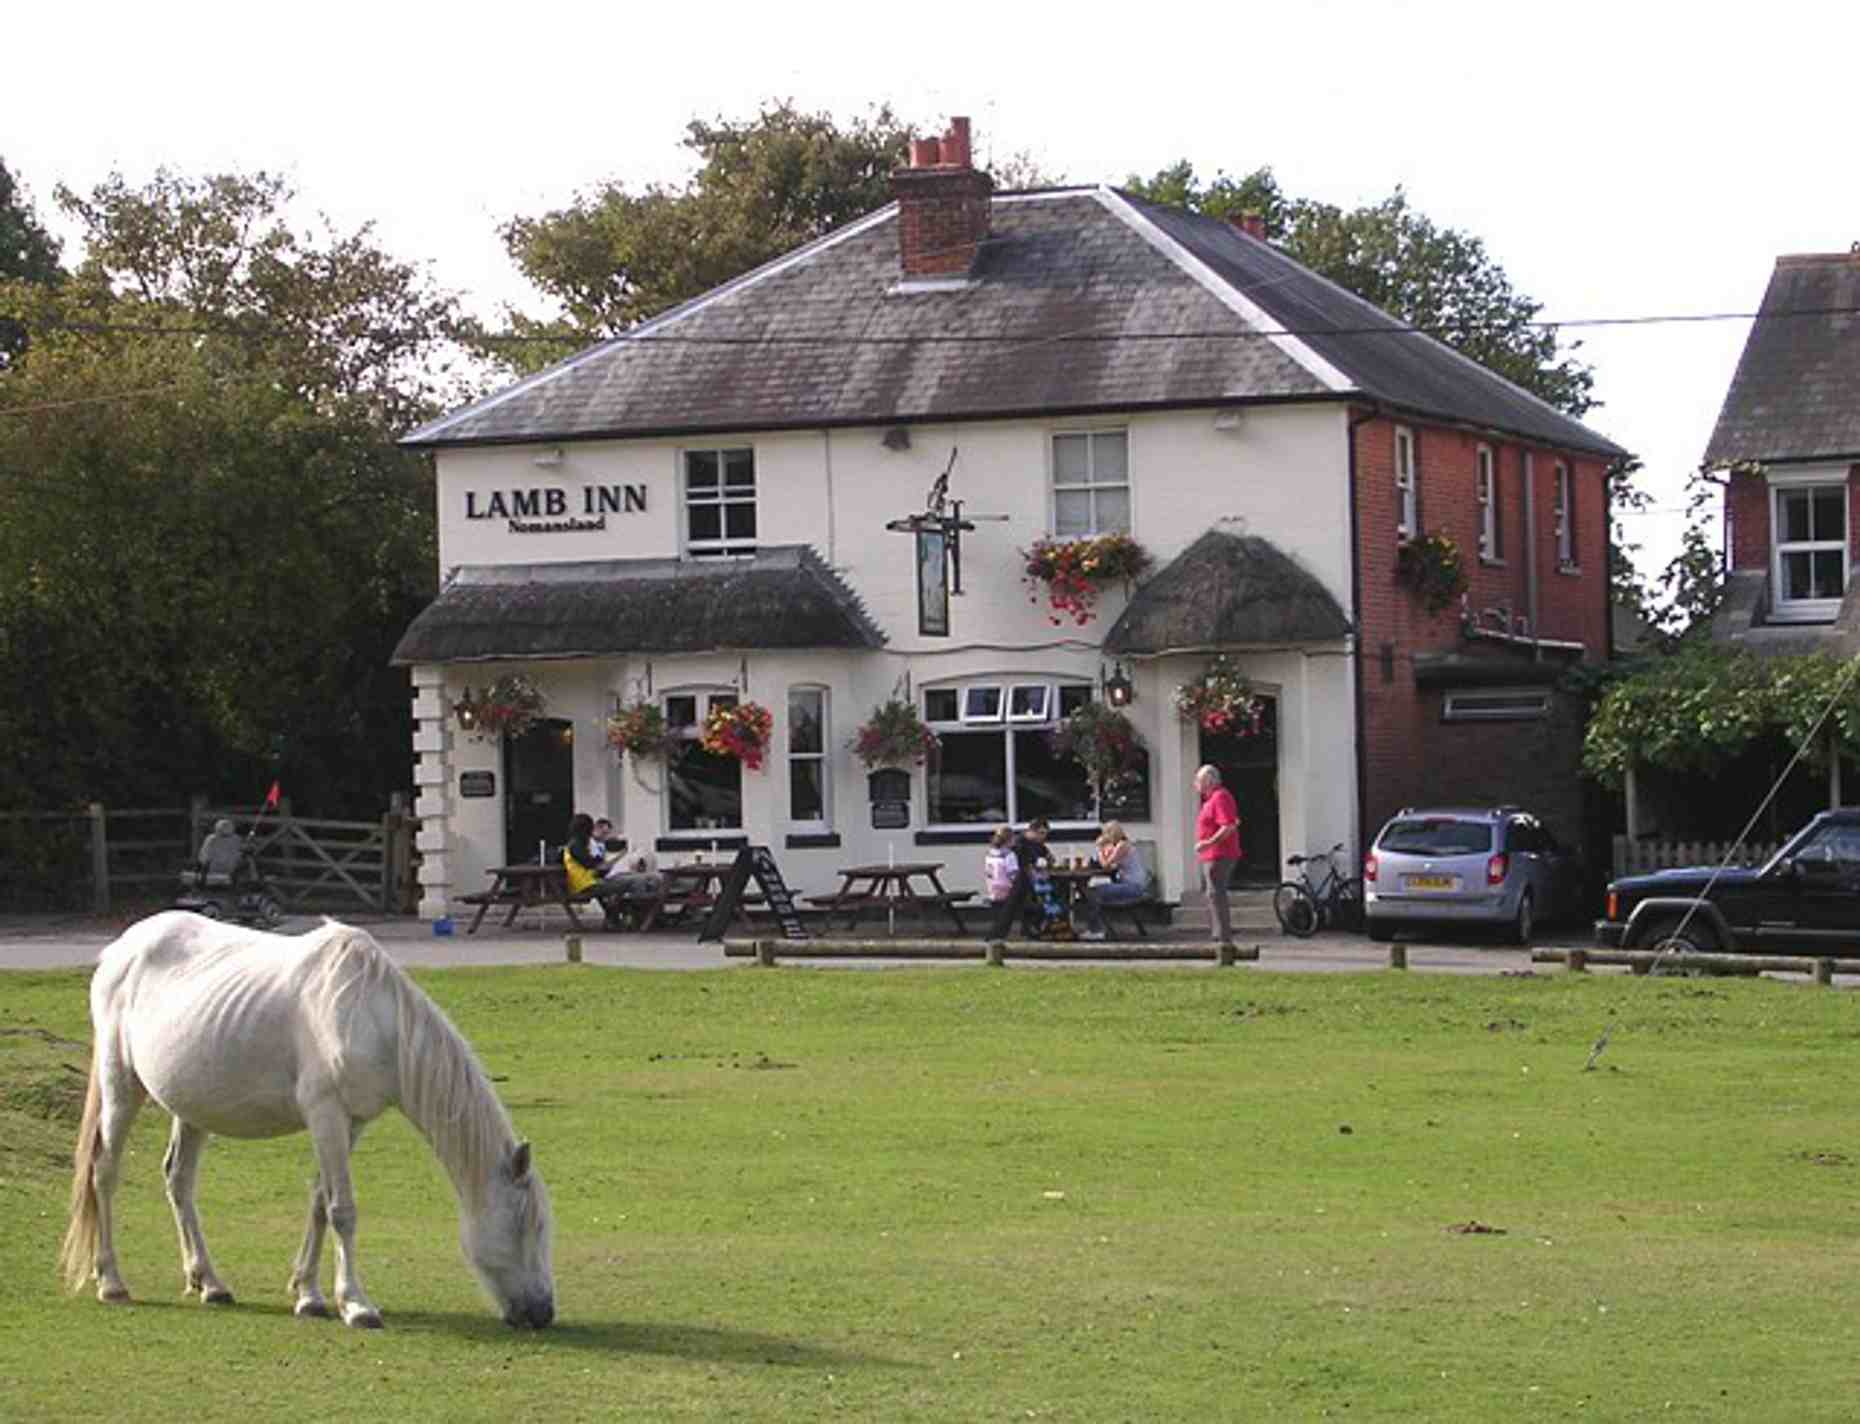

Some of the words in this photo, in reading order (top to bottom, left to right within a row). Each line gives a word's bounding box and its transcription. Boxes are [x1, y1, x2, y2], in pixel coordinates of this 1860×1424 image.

[465, 488, 567, 519] LAMB
[583, 484, 647, 514] INN
[508, 515, 606, 533] Nomansland
